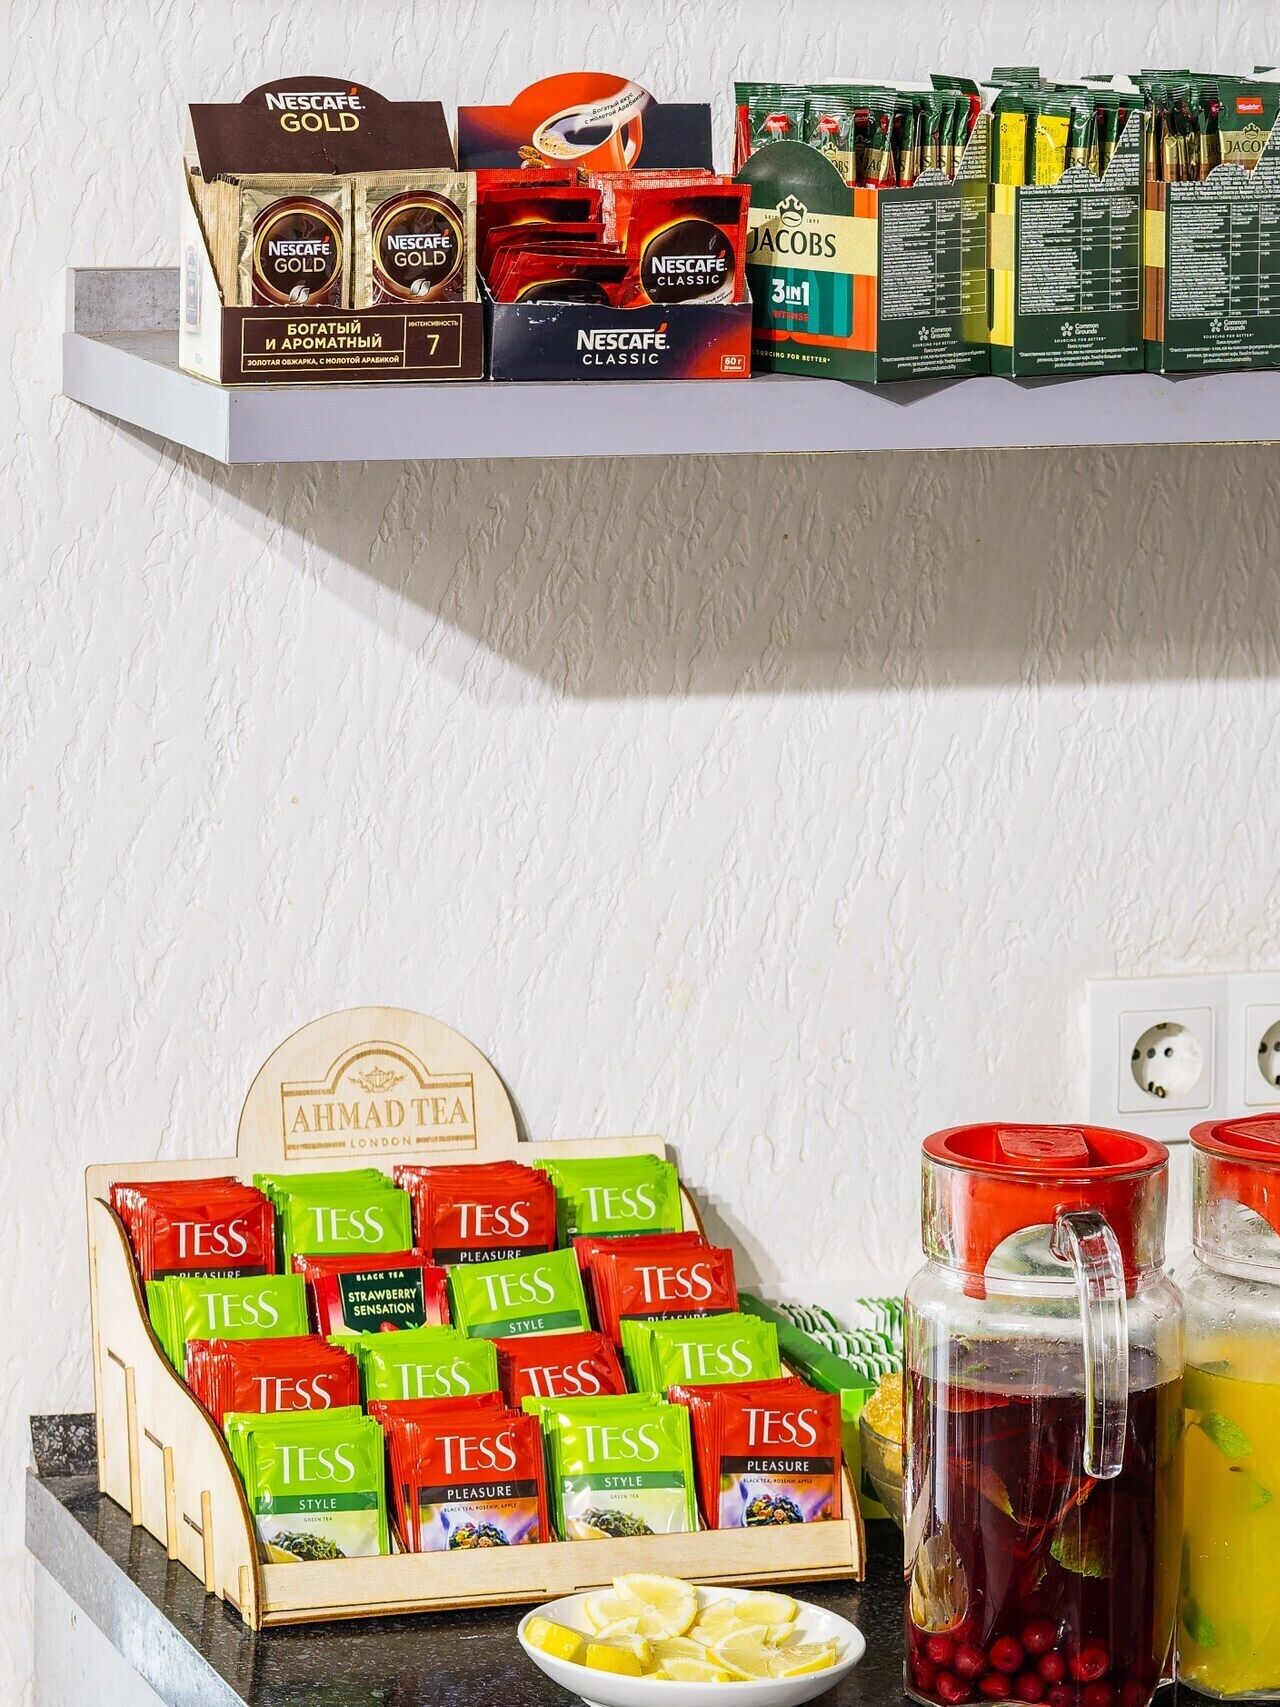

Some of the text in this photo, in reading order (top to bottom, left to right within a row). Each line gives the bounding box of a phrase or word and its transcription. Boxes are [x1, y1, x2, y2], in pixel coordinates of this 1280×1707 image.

[265, 87, 365, 110] NESCAFÉ
[280, 113, 360, 132] GOLD
[268, 236, 331, 256] NESCAFÉ
[387, 229, 452, 249] NESCAFÉ
[748, 227, 836, 258] JACOBS
[274, 258, 326, 273] GOLD
[394, 251, 446, 267] GOLD
[652, 250, 727, 274] NESCAFÉ
[657, 275, 720, 286] CLASSIC
[408, 320, 459, 328] ИНТЕНСИВНОСТЬ
[771, 309, 809, 321] INTENSE
[287, 320, 361, 336] БОГАТЫЙ
[577, 322, 670, 350] NESCAFÉ
[265, 333, 382, 350] И АРОМАТНЫЙ
[426, 334, 440, 356] 7
[281, 358, 318, 366] ОБЖАРКА,
[326, 356, 360, 364] МОЛОТОЙ
[361, 355, 400, 364] АРАБИКОЙ
[582, 353, 659, 365] CLASSIC
[725, 357, 737, 365] 60
[291, 1097, 468, 1133] AHMAD TEA
[351, 1136, 412, 1149] LONDON
[582, 1183, 656, 1222] TESS
[308, 1206, 385, 1243] TESS
[453, 1201, 530, 1238] TESS
[171, 1220, 247, 1258] TESS
[460, 1250, 521, 1262] PLEASURE
[356, 1271, 404, 1281] BLACK TEA
[634, 1263, 712, 1303] TESS
[348, 1288, 416, 1303] STRAWBERRY
[478, 1267, 555, 1311] TESS
[199, 1291, 278, 1330] TESS
[353, 1303, 415, 1316] SENSATION
[509, 1319, 544, 1332] STYLE
[674, 1339, 752, 1379] TESS
[393, 1361, 470, 1399] TESS
[520, 1360, 600, 1398] TESS
[252, 1374, 332, 1412] TESS
[742, 1408, 817, 1448] TESS
[578, 1423, 660, 1462] TESS
[274, 1442, 355, 1484] TESS
[436, 1432, 516, 1474] TESS
[747, 1461, 810, 1472] PLEASURE
[604, 1475, 643, 1487] STYLE
[447, 1485, 512, 1500] PLEASURE
[299, 1498, 337, 1511] STYLE
